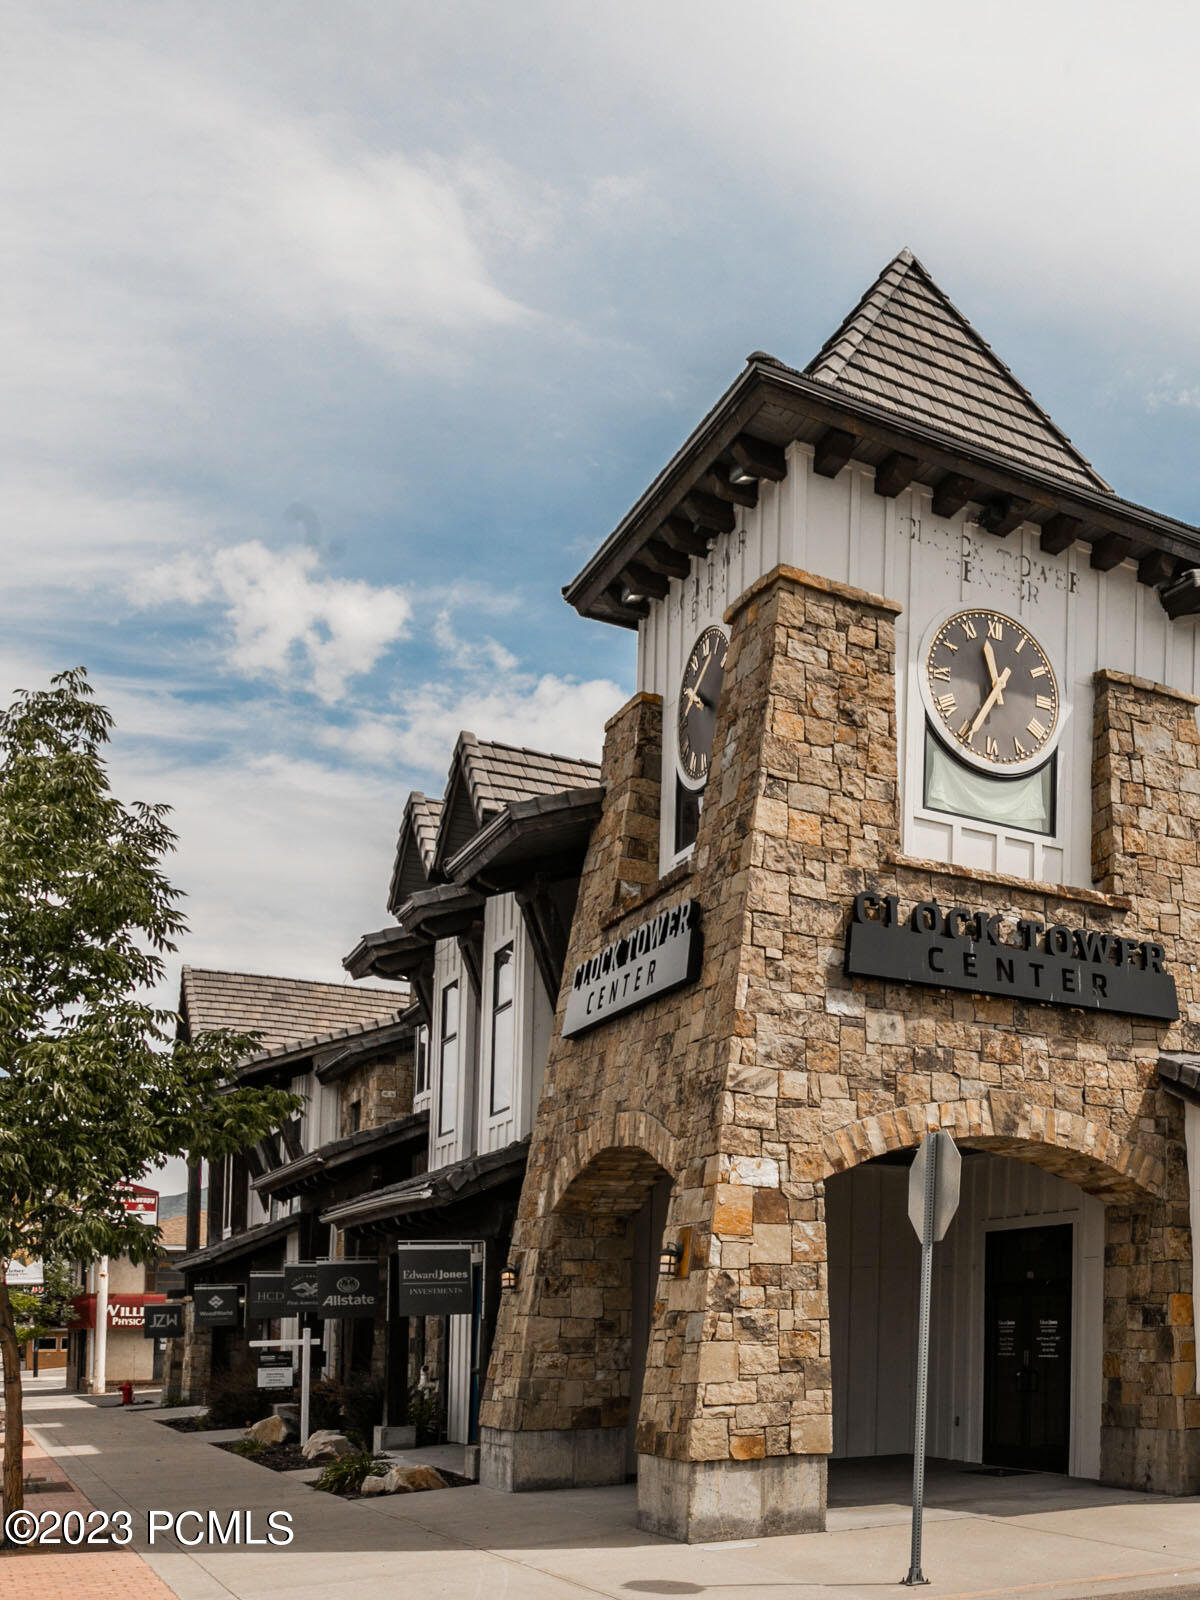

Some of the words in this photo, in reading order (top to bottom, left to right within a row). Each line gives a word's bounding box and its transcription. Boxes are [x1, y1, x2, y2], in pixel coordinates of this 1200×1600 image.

[573, 939, 625, 990] CLOCK
[627, 900, 692, 962] TOWER
[854, 890, 1004, 946] CLOCK
[1016, 918, 1167, 975] TOWER
[586, 959, 657, 1015] CENTER
[928, 947, 1108, 999] CENTER
[322, 1294, 375, 1307] Allstate
[403, 1269, 438, 1280] Edward
[439, 1269, 468, 1280] Jones
[409, 1287, 463, 1296] INVESTMENTS
